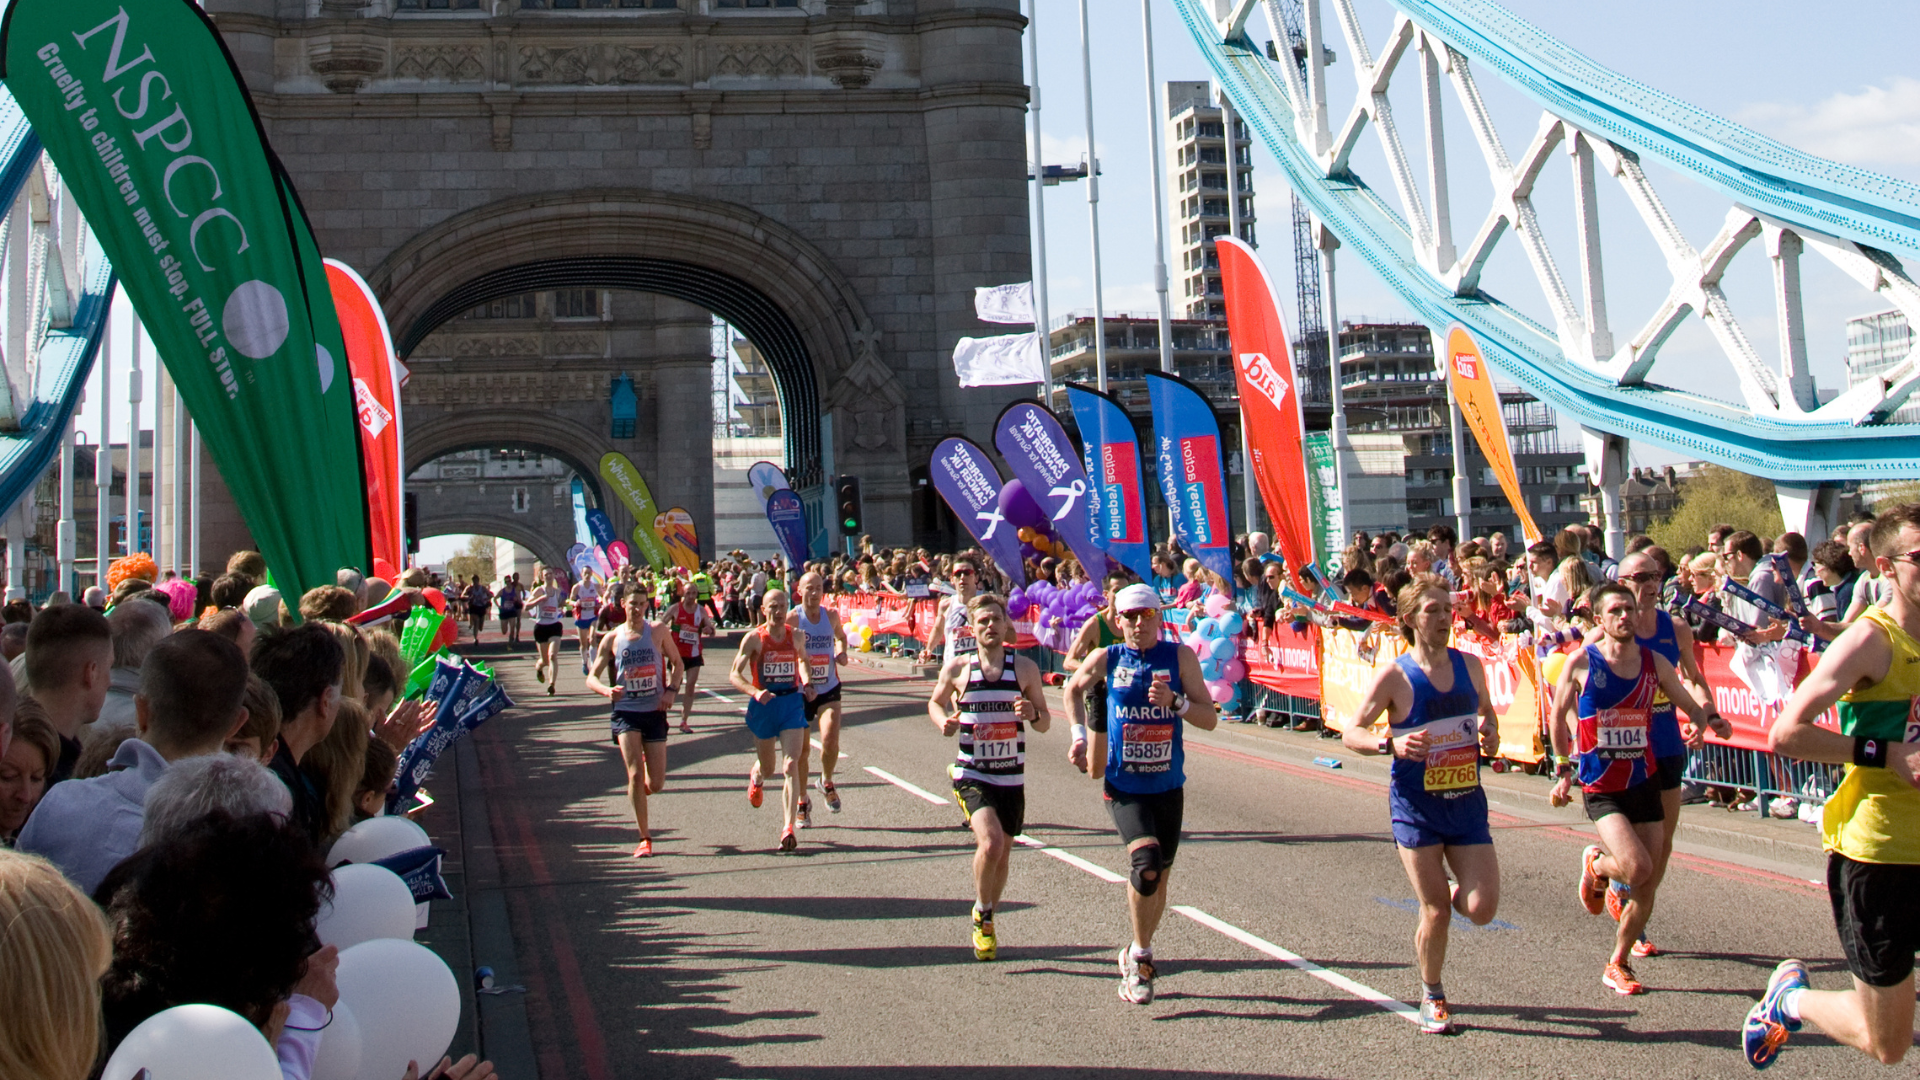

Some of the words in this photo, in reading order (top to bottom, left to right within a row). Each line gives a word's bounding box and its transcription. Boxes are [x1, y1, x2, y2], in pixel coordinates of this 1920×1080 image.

[72, 5, 250, 272] NSPCC
[36, 42, 87, 111] Cruelty
[78, 107, 99, 131] to
[91, 131, 140, 206] children
[133, 206, 170, 254] must
[160, 254, 190, 301] stop.
[183, 297, 218, 348] FULL
[209, 346, 239, 400] STOP.
[954, 637, 977, 649] 2477
[632, 648, 654, 656] ROYAL
[632, 655, 654, 664] FORCE
[1284, 648, 1310, 675] money
[765, 662, 793, 674] 57131
[630, 678, 653, 689] 1146
[1716, 685, 1767, 727] money
[1115, 706, 1176, 720] MARCIN
[1620, 713, 1646, 722] money
[994, 728, 1016, 738] money
[1146, 729, 1172, 737] money
[1426, 730, 1462, 745] Sands
[1604, 729, 1640, 746] 1104
[424, 730, 439, 752] HELP
[980, 741, 1011, 757] 1171
[1124, 741, 1171, 759] 55857
[1615, 750, 1644, 759] #boost
[1450, 751, 1476, 761] money
[989, 760, 1016, 769] #boost
[1138, 763, 1170, 772] #boost
[1426, 765, 1476, 786] 32766
[424, 873, 430, 881] A
[411, 880, 432, 891] APITAL
